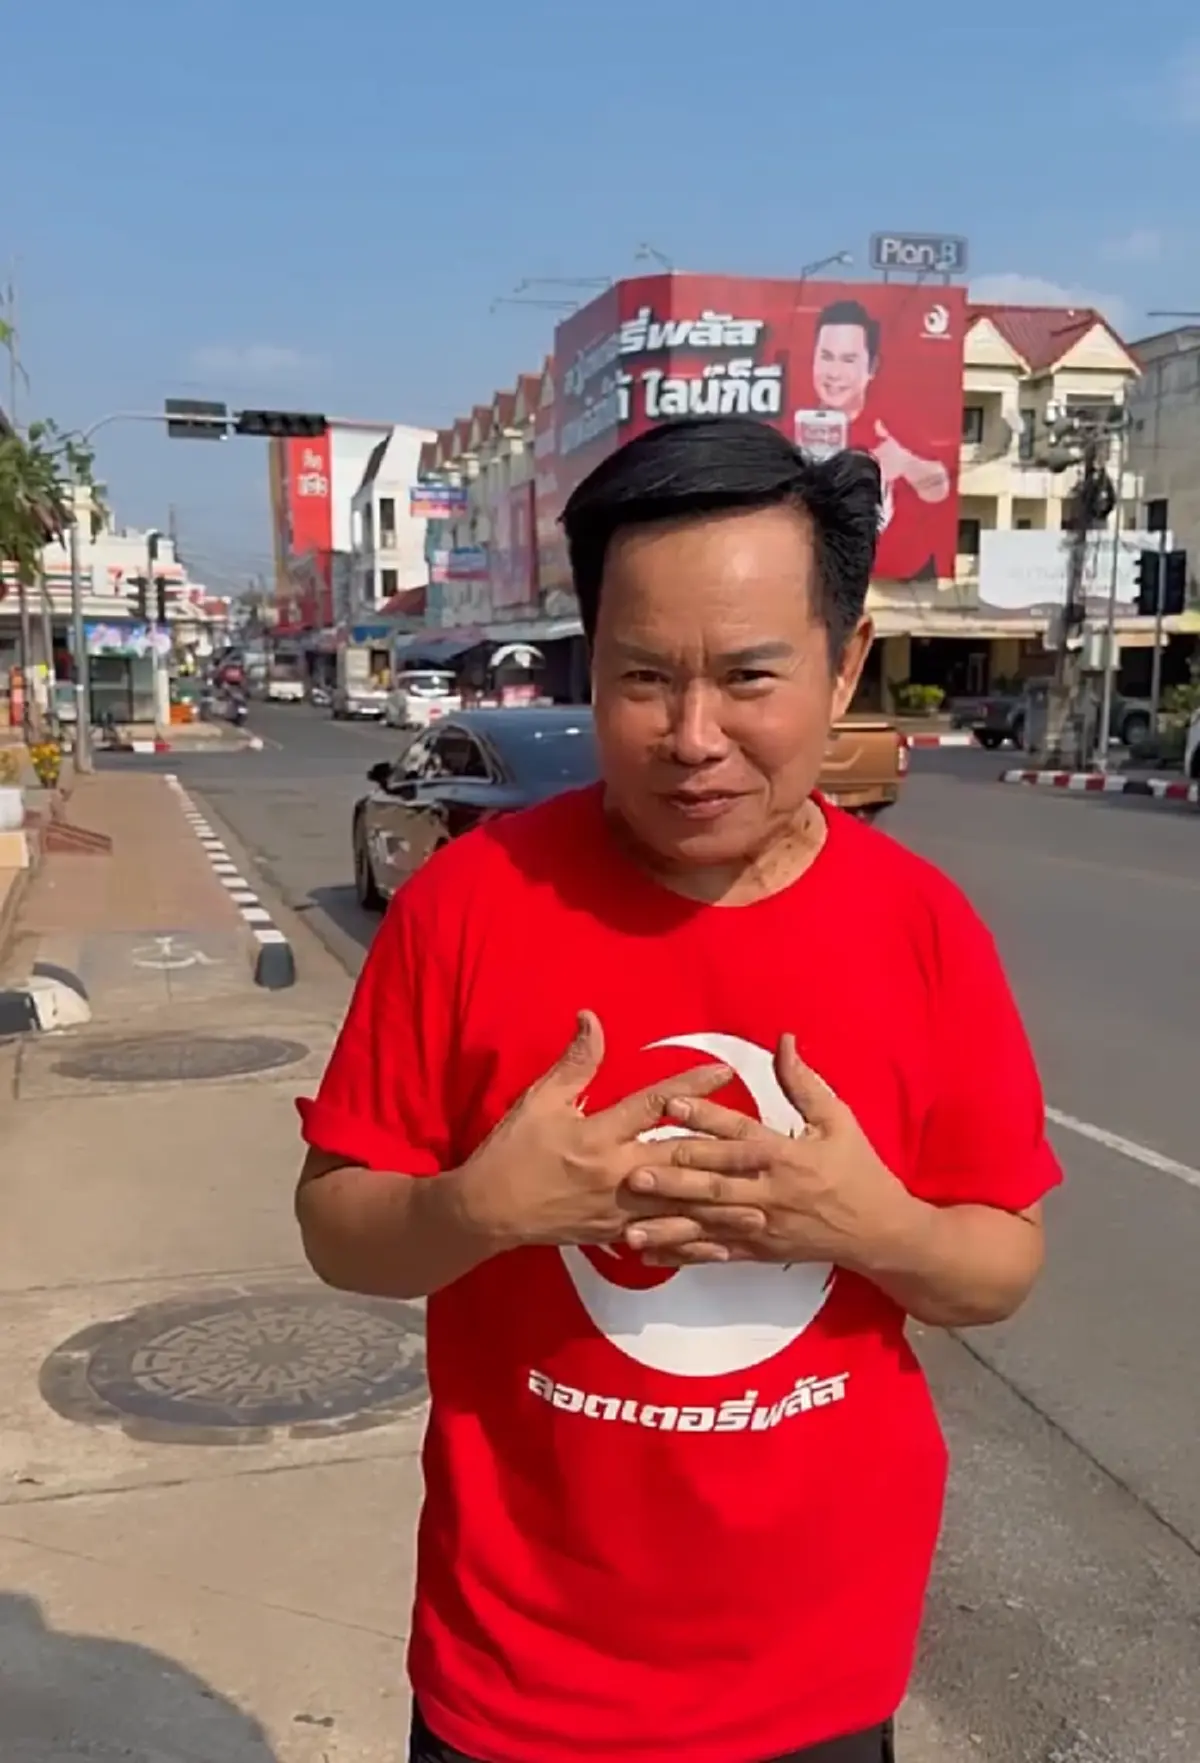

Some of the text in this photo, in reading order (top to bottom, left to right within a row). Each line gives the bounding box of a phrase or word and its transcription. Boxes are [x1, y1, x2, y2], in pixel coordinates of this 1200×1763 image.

[881, 238, 934, 264] Plan
[527, 1369, 851, 1432] ลอตเตอรี่พลัส
